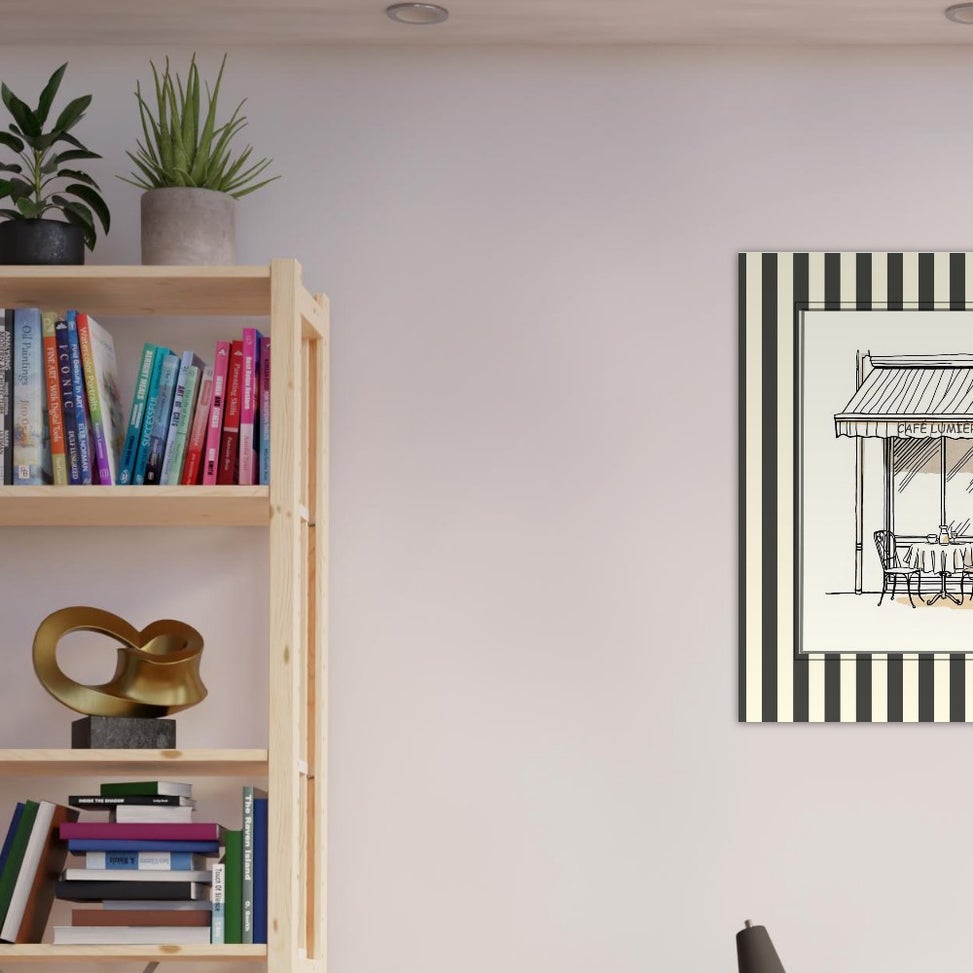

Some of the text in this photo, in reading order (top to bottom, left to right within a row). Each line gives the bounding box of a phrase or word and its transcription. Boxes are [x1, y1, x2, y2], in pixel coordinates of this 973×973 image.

[18, 325, 33, 385] Oil Paintings
[80, 327, 98, 412] Watercolor Portraits
[59, 344, 73, 408] ICONIC
[73, 360, 81, 385] Beauty
[75, 395, 83, 409] ART
[229, 363, 241, 415] Parenting Skills
[49, 402, 61, 424] Digital
[80, 440, 89, 472] NORMAN
[245, 794, 253, 814] The
